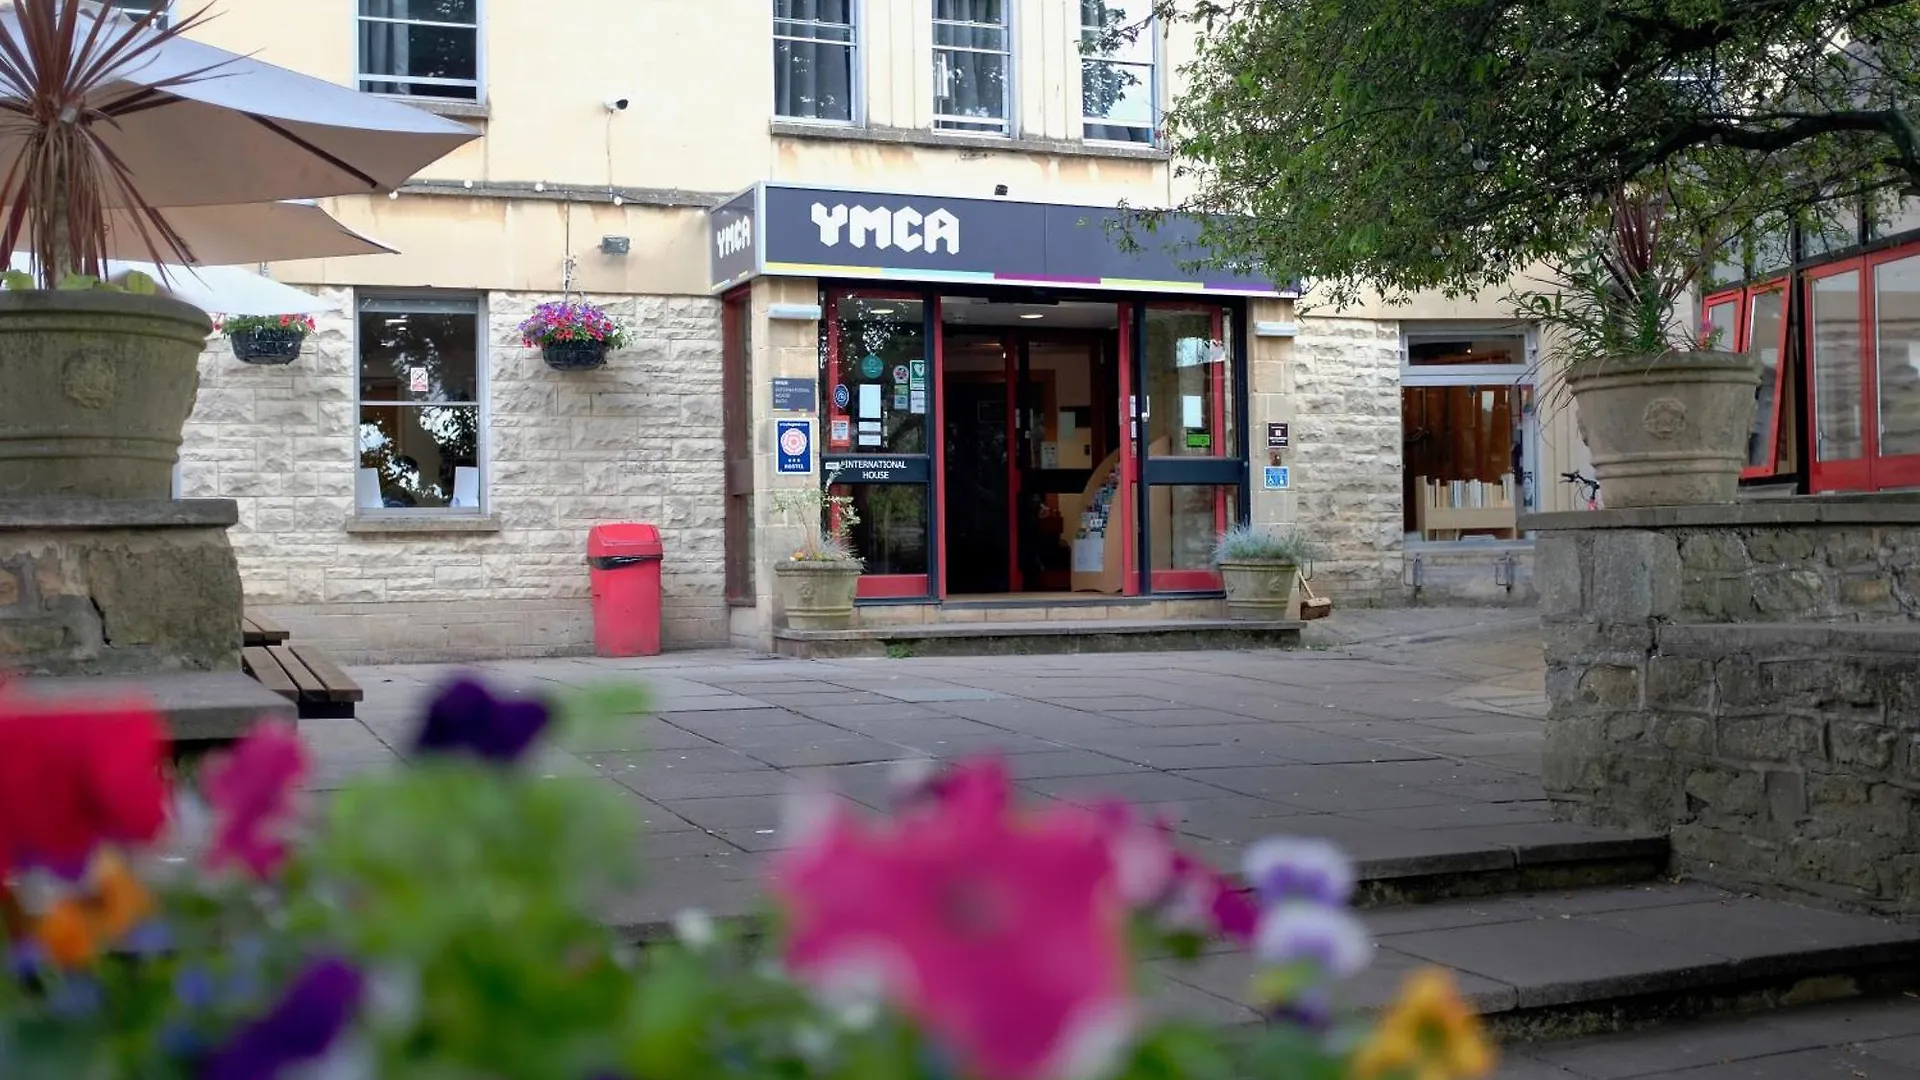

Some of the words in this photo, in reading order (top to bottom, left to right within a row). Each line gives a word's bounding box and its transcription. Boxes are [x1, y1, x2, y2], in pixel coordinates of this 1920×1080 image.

[717, 215, 750, 259] YMCA
[811, 202, 960, 255] YMCA
[845, 460, 907, 469] INTERNATIONAL
[862, 471, 890, 479] HOUSE
